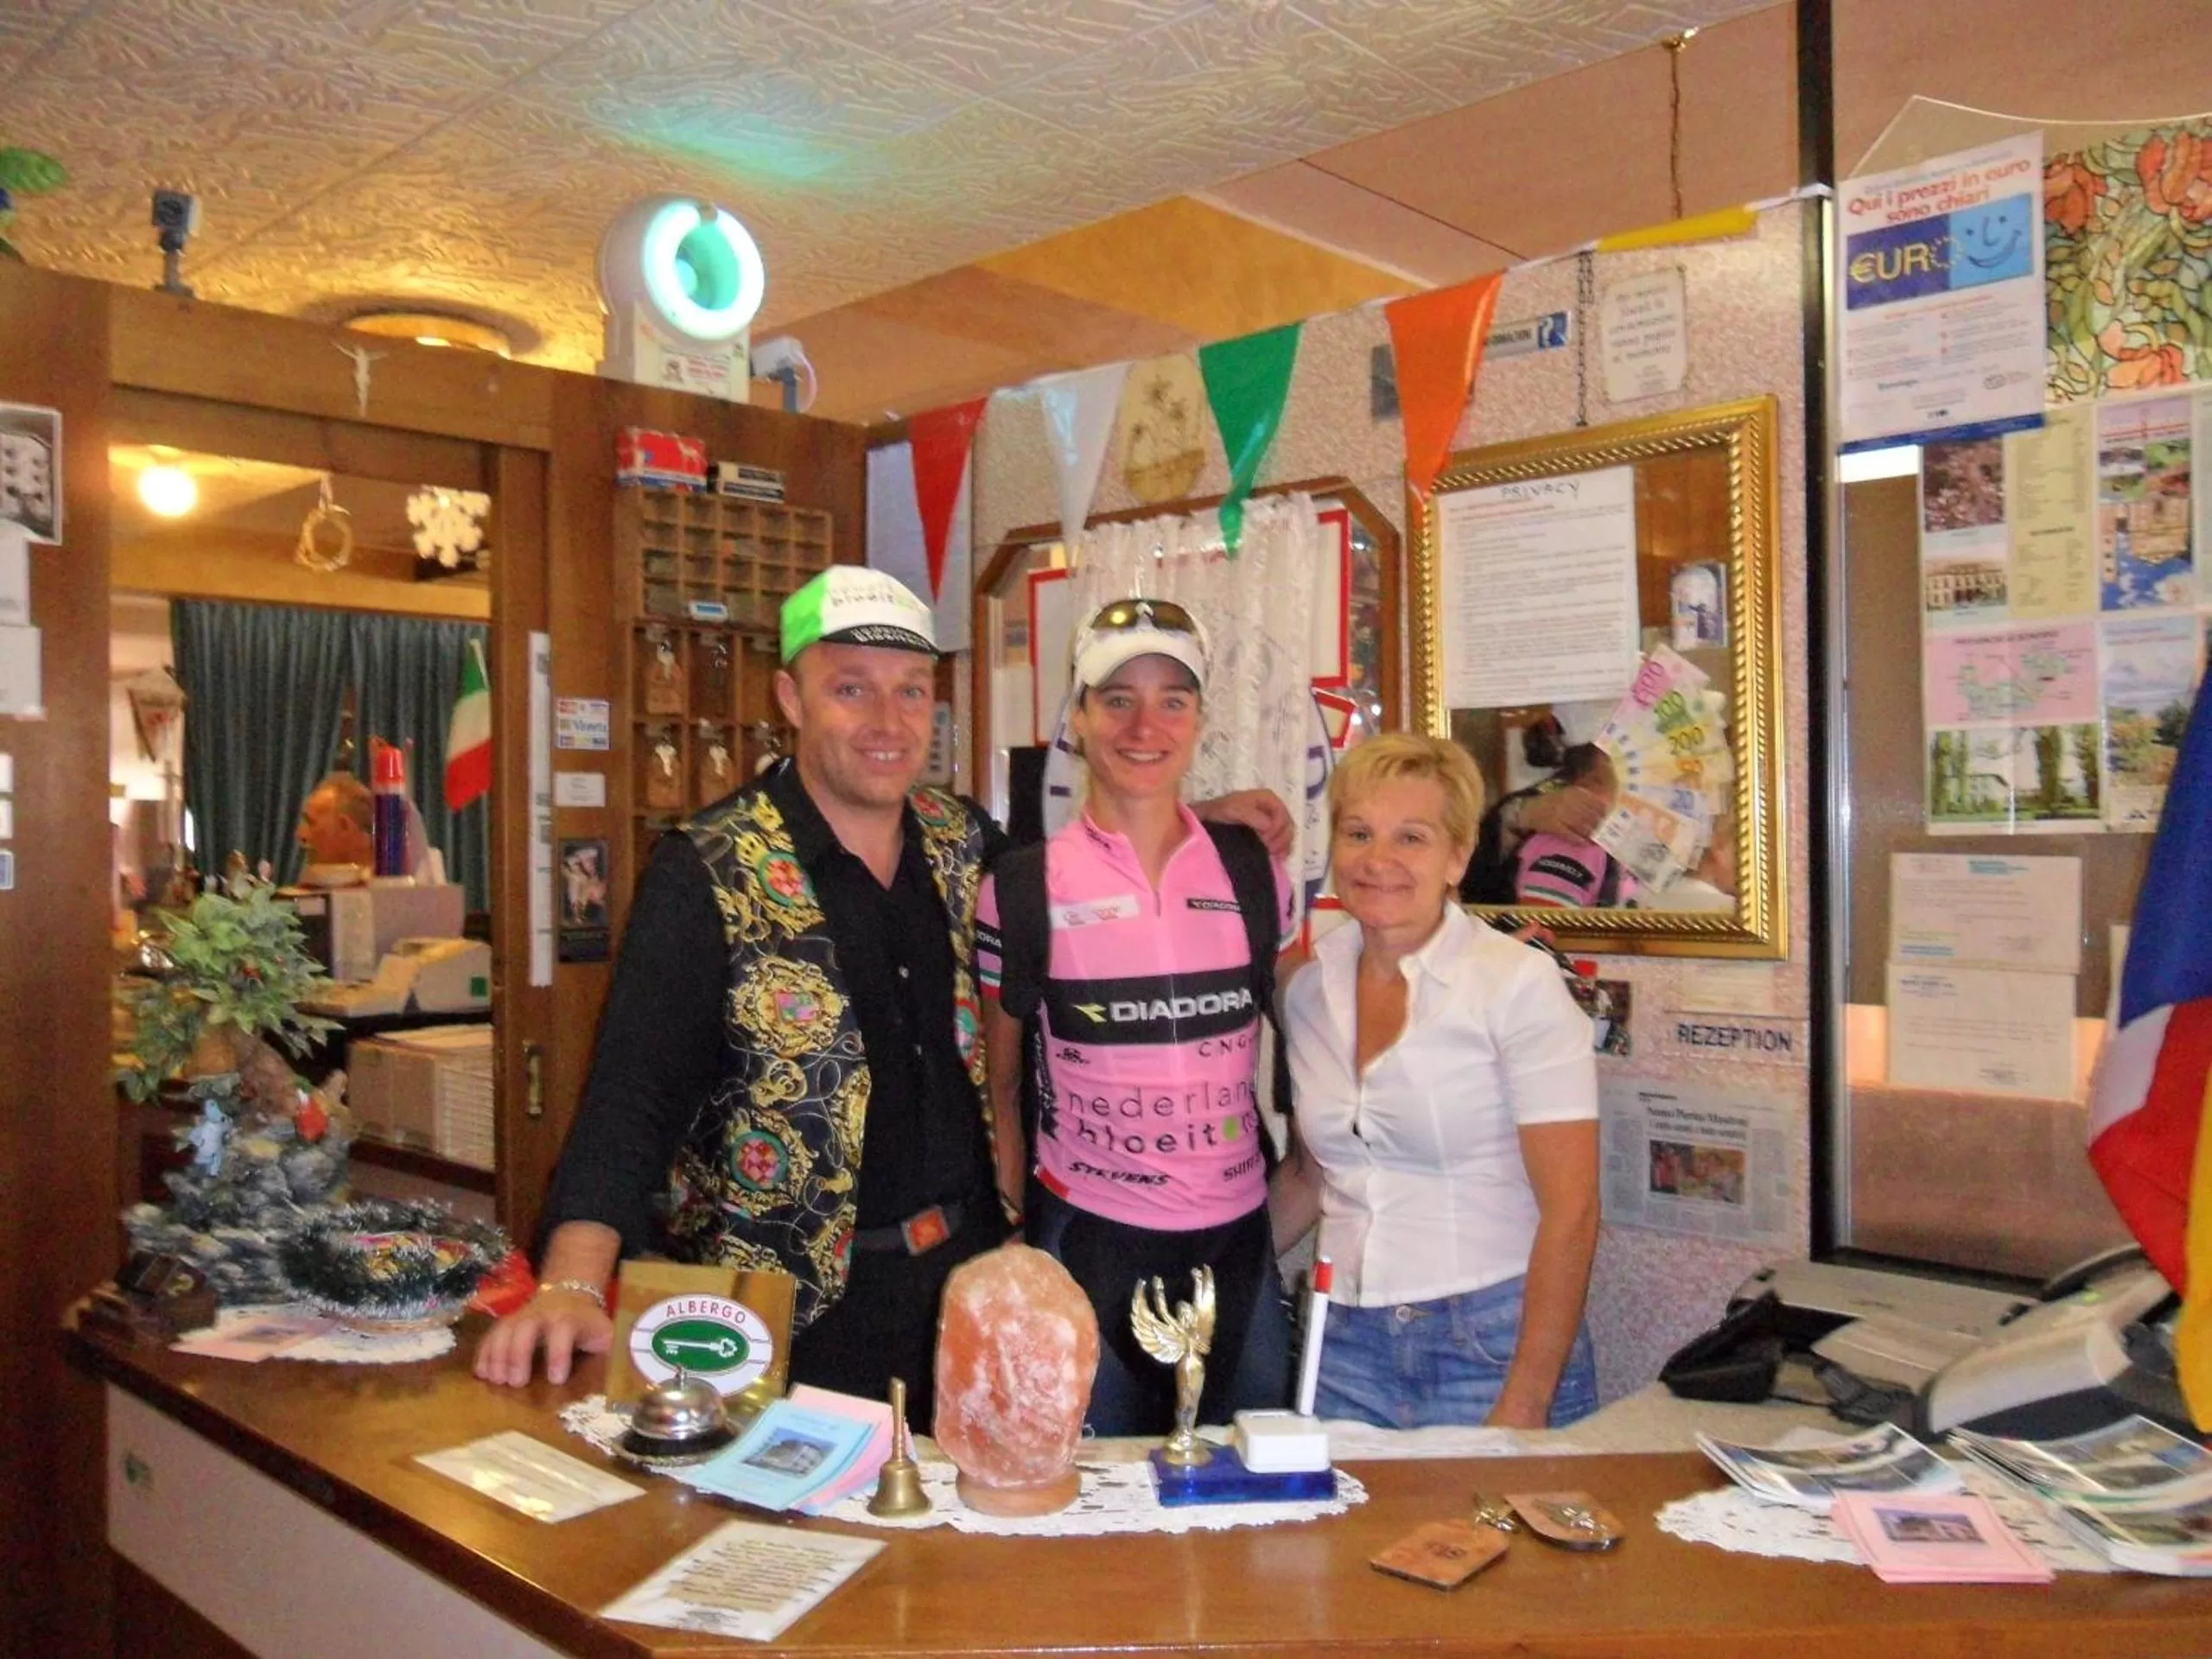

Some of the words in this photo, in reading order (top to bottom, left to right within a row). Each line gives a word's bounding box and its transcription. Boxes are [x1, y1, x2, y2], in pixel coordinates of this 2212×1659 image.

[1848, 196, 1883, 215] Qui
[1897, 180, 1957, 205] prezzi
[1962, 173, 1980, 185] in
[1985, 160, 2031, 181] euro
[1887, 203, 1931, 222] sono
[1501, 478, 1581, 500] PRIVACY
[1109, 987, 1253, 1023] DIADORA
[1678, 1023, 1793, 1052] REZEPTION
[666, 1300, 746, 1324] ALBERGO
